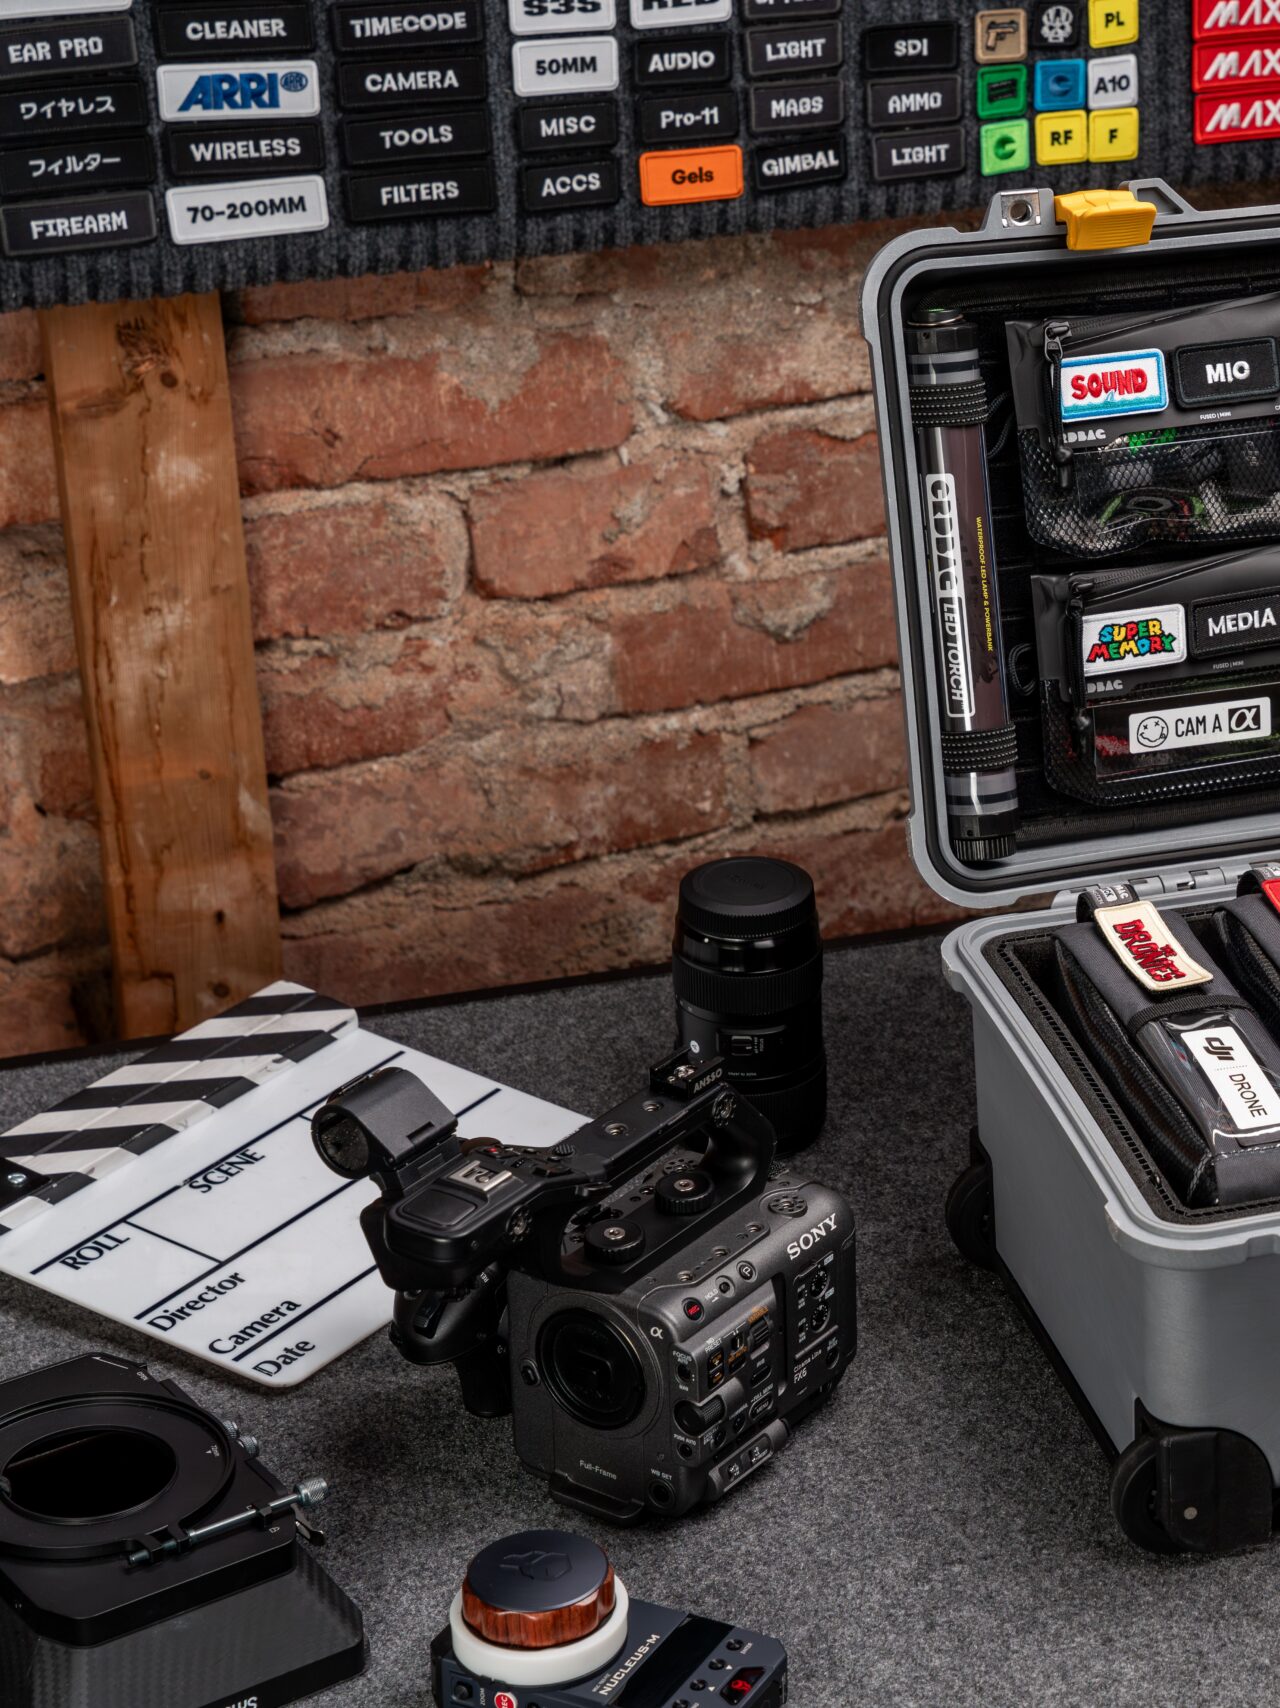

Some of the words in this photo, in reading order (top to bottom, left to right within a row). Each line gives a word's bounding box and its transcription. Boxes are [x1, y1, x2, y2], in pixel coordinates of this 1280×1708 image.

[186, 19, 287, 41] CLEANER
[350, 12, 468, 38] TIMECODE
[1105, 11, 1124, 27] PL
[8, 44, 52, 64] EAR
[60, 36, 103, 57] PRO
[766, 39, 826, 61] LIGHT
[894, 39, 928, 57] SDI
[536, 56, 597, 75] 50MM
[648, 51, 714, 72] AUDIO
[178, 72, 281, 112] ARRI
[365, 70, 459, 93] CAMERA
[1094, 75, 1130, 92] A10
[19, 96, 116, 120] ワイヤレス
[771, 97, 823, 119] MAGS
[889, 92, 942, 114] AMMO
[540, 116, 596, 137] MISC
[660, 109, 719, 129] Pro-11
[380, 126, 454, 149] TOOLS
[1050, 130, 1073, 146] RF
[1108, 129, 1118, 145] F
[190, 138, 301, 162] WIRELESS
[892, 144, 949, 165] LIGHT
[29, 154, 121, 178] フィルター
[762, 151, 838, 176] GIMBAL
[541, 174, 600, 197] ACCS
[671, 167, 714, 185] Gels
[380, 182, 459, 206] FILTERS
[187, 196, 307, 224] 70-200MM
[30, 211, 129, 240] FIREARM
[1071, 367, 1147, 400] SOUND
[1205, 360, 1250, 384] MIC
[1063, 428, 1106, 443] RDBAG
[976, 516, 986, 565] WATERPROOF
[984, 607, 994, 652] POWERBANK
[1099, 618, 1162, 643] SUPER
[1208, 608, 1277, 636] MEDIA
[1087, 633, 1177, 662] MEMORY
[946, 640, 967, 701] TORCH
[1086, 680, 1124, 694] DBAG
[1175, 715, 1206, 738] CAM
[1212, 713, 1222, 733] A
[1112, 918, 1187, 982] DRONES
[1229, 1072, 1268, 1119] DRONE
[189, 1148, 266, 1194] SCENE
[786, 1213, 838, 1261] SONY
[59, 1232, 130, 1271] ROLL
[147, 1269, 246, 1332] Director
[208, 1296, 301, 1355] Camera
[252, 1337, 316, 1377] Date
[599, 1633, 661, 1696] NUCLEUS-M
